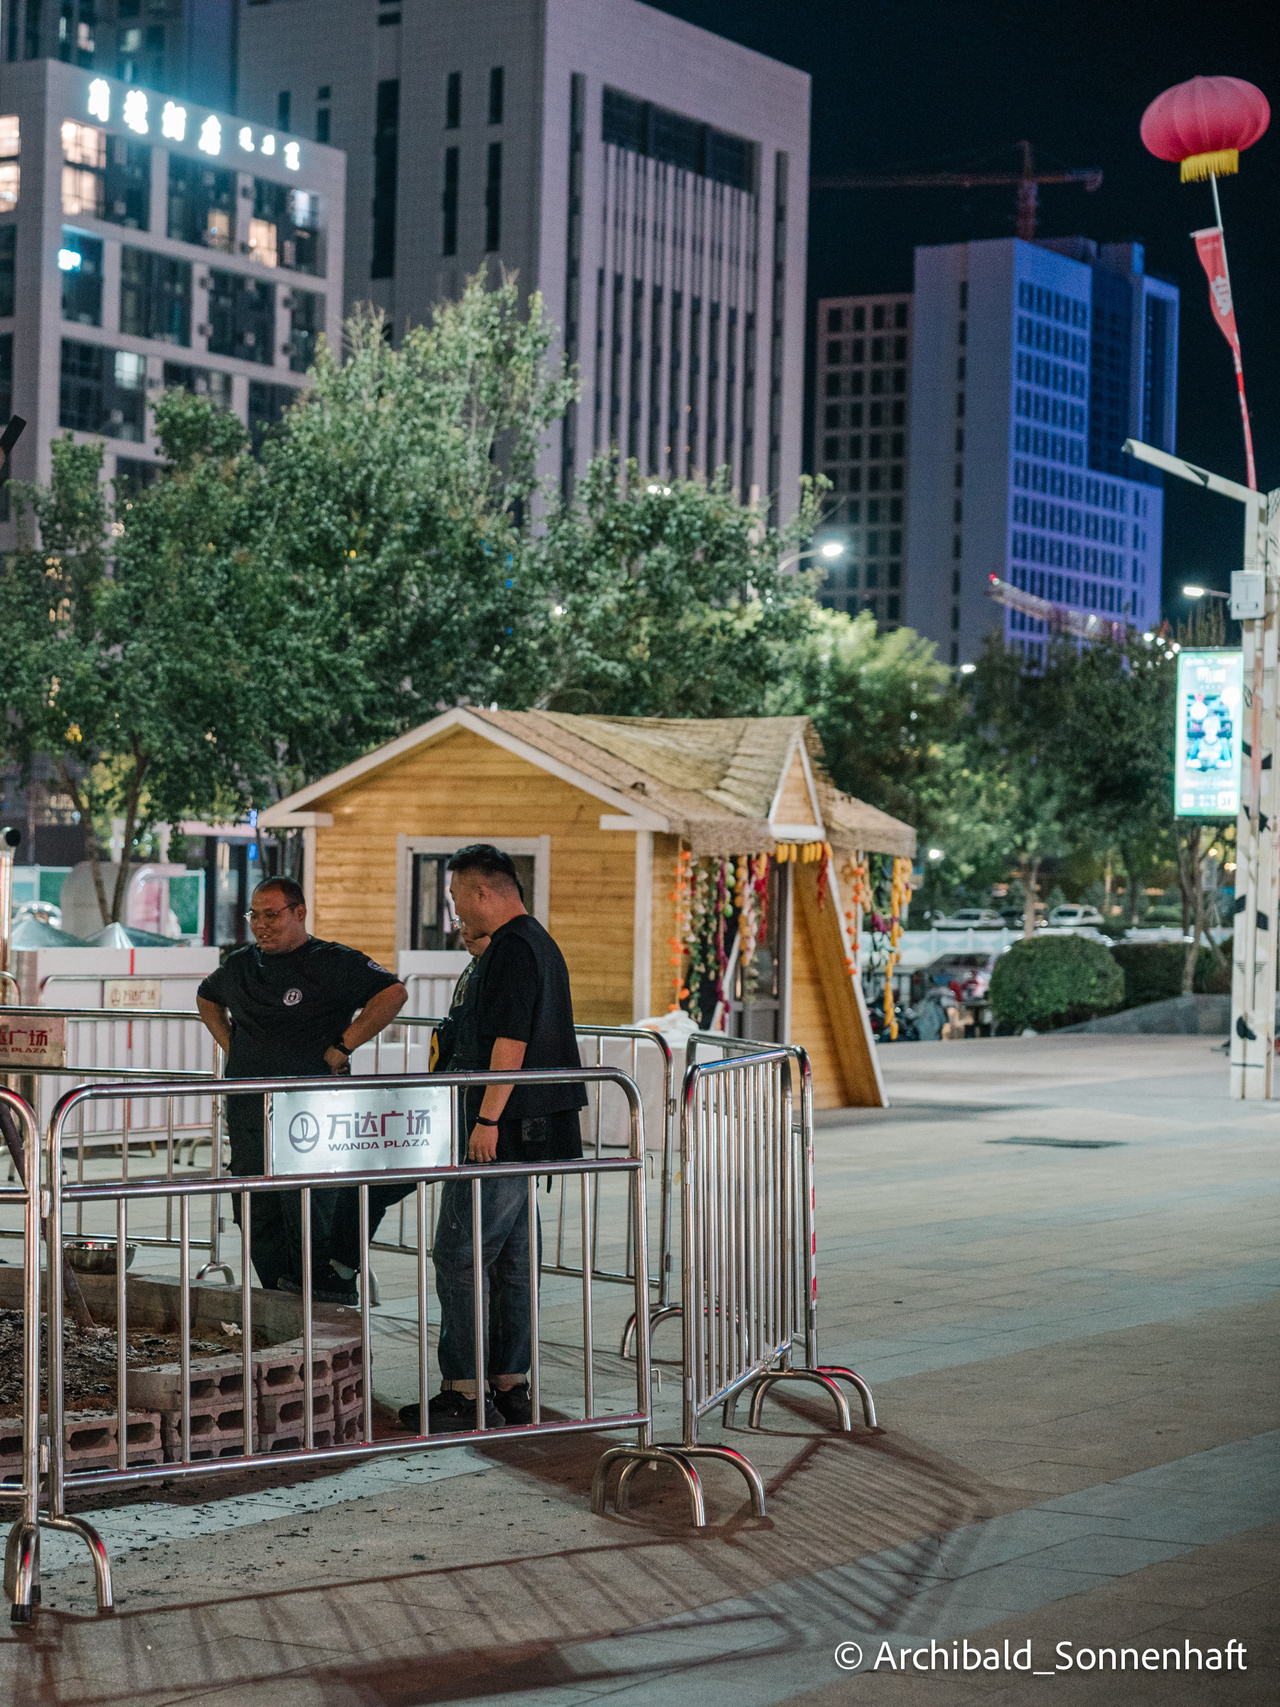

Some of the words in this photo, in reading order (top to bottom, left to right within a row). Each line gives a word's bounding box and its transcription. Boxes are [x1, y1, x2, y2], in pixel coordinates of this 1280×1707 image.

[11, 1046, 47, 1054] PLAZA
[326, 1109, 432, 1140] 万达广场
[328, 1141, 380, 1152] WANDA
[384, 1138, 431, 1149] PLAZA
